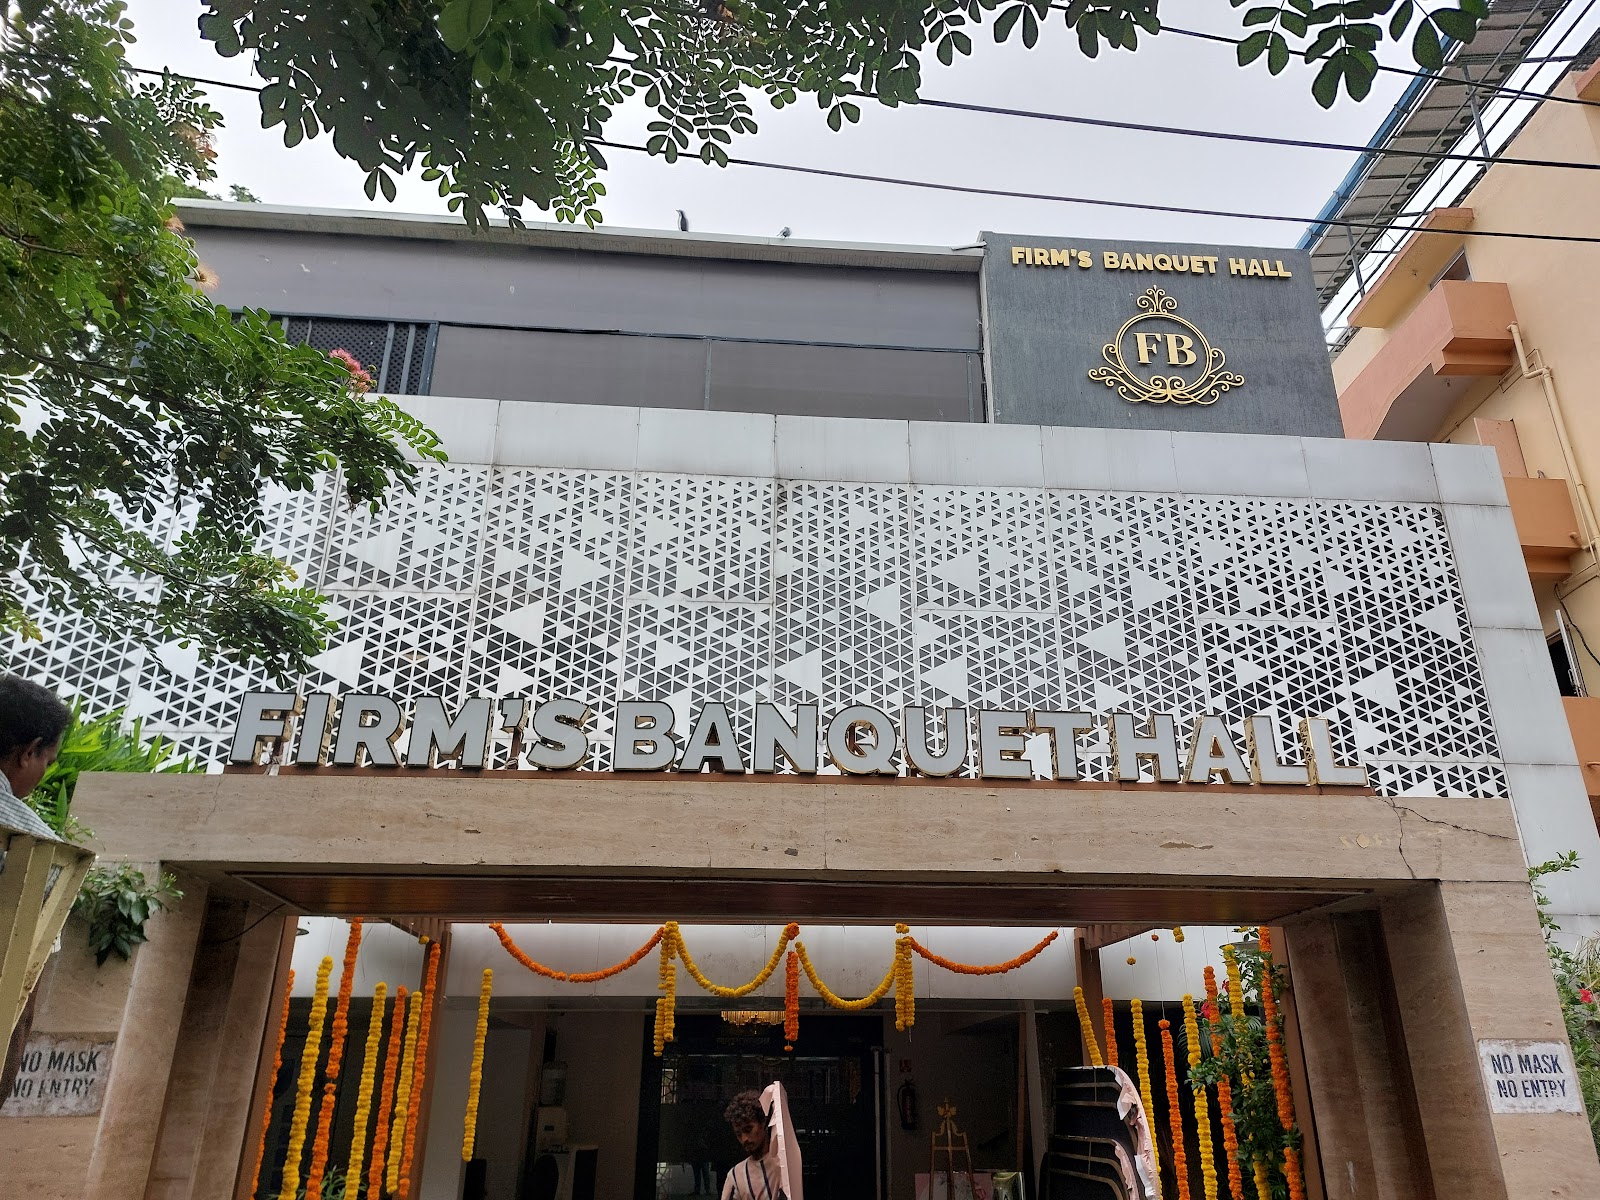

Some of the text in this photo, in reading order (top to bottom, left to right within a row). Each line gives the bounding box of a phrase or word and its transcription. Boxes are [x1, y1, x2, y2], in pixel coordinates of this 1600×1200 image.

[1011, 245, 1292, 279] FIRM'S BANQUET HALL
[1133, 332, 1198, 367] FB
[229, 692, 1369, 787] FIRM'S BANQUET HALL
[48, 1050, 101, 1073] MASK
[1490, 1053, 1564, 1075] NO MASK
[37, 1077, 96, 1099] ENTRY
[1496, 1079, 1566, 1098] NO ENTRY
